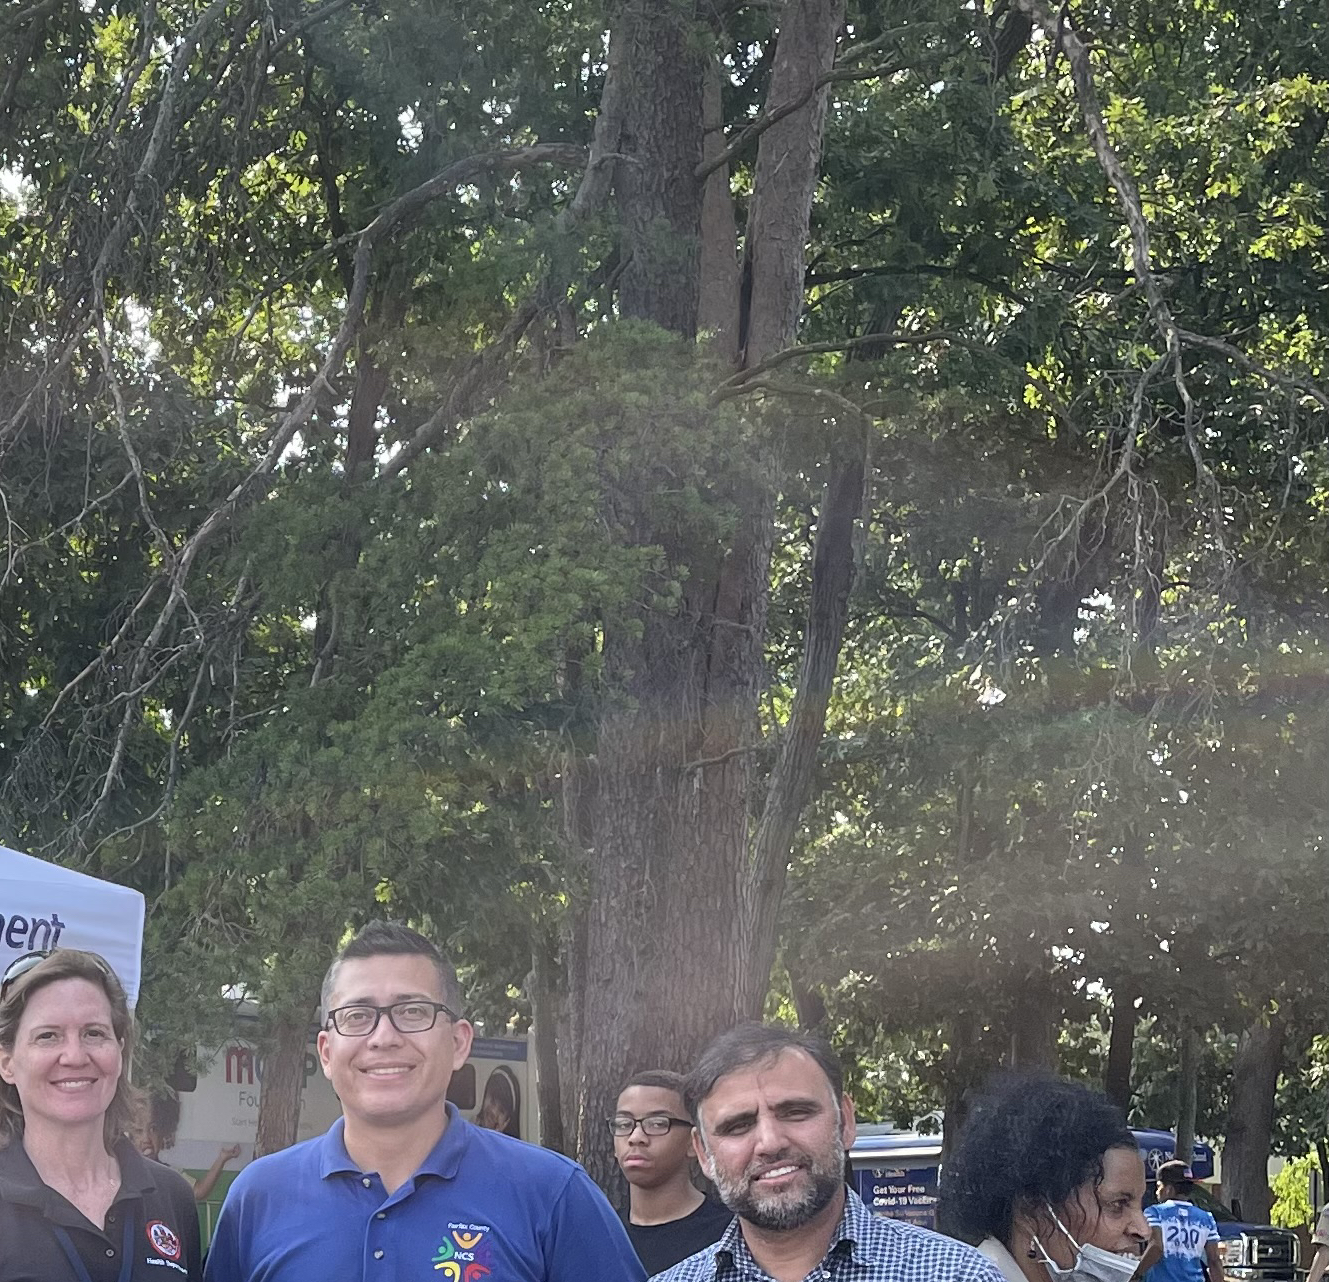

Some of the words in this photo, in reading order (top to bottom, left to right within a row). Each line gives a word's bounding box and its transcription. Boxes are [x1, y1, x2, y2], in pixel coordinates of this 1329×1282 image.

[873, 1185, 887, 1194] Get
[888, 1185, 907, 1194] Your
[908, 1184, 926, 1193] Free
[873, 1197, 907, 1206] Covid-19
[469, 1224, 490, 1232] County
[454, 1252, 475, 1262] NCS
